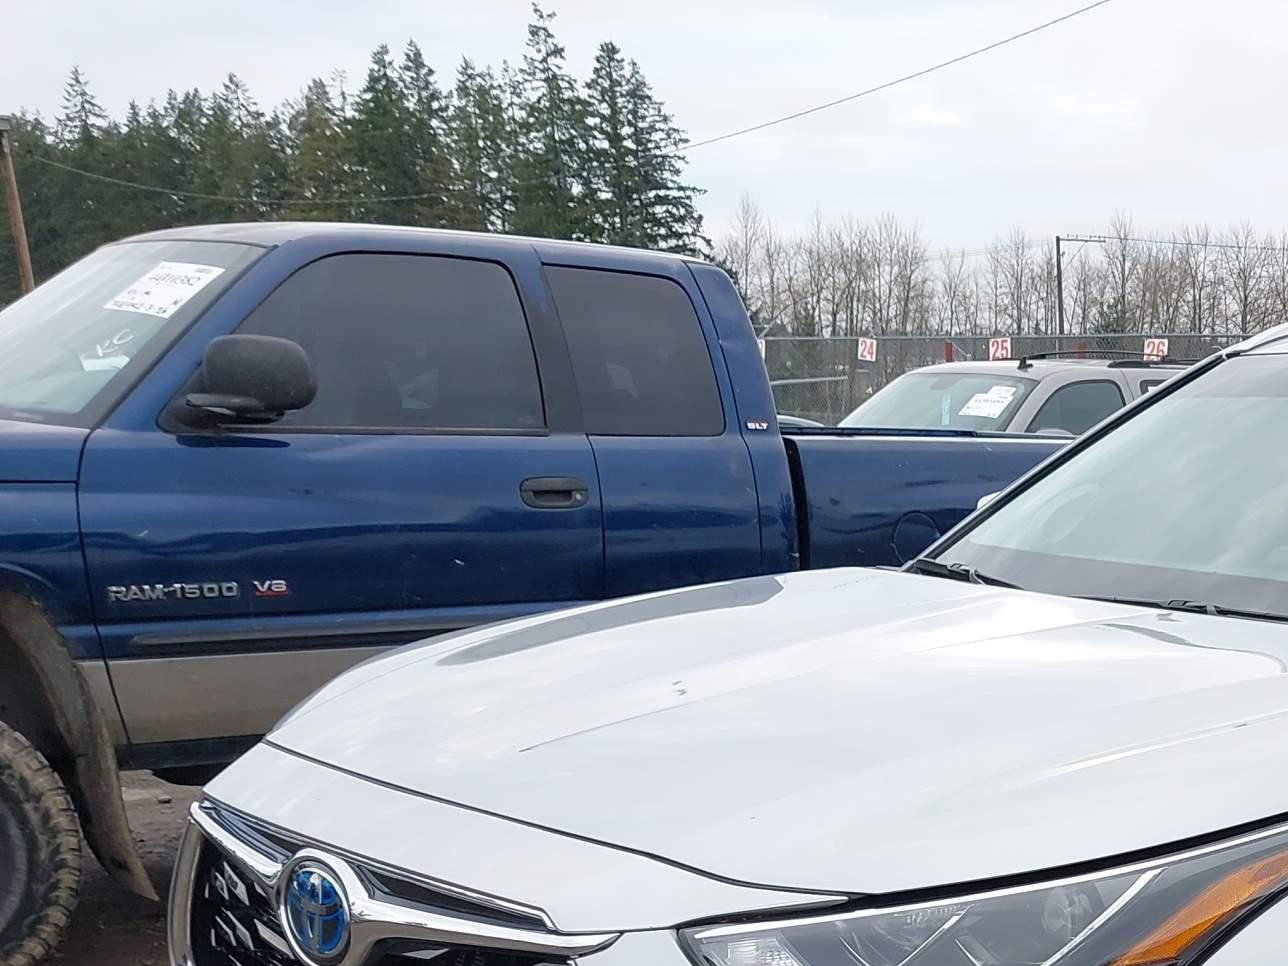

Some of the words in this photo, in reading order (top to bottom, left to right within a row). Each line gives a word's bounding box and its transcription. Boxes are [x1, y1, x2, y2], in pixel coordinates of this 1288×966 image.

[860, 340, 874, 359] 24
[991, 339, 1009, 360] 25
[252, 579, 288, 593] V8
